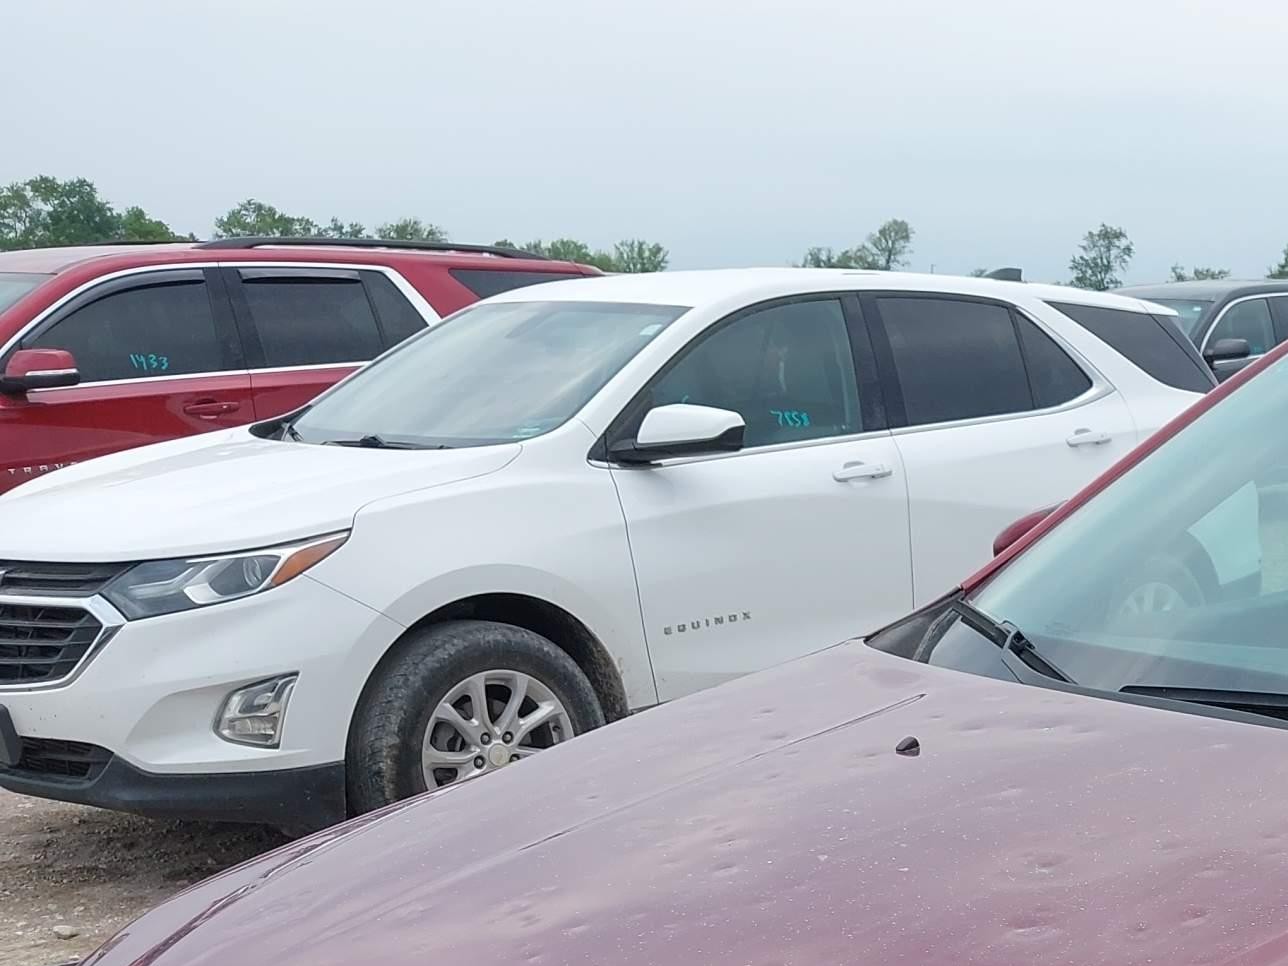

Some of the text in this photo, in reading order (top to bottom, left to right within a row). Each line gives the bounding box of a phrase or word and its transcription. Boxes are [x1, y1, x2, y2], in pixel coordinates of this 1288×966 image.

[129, 353, 170, 371] 1433
[7, 461, 79, 475] TRAV
[663, 610, 752, 636] EQUINOX
